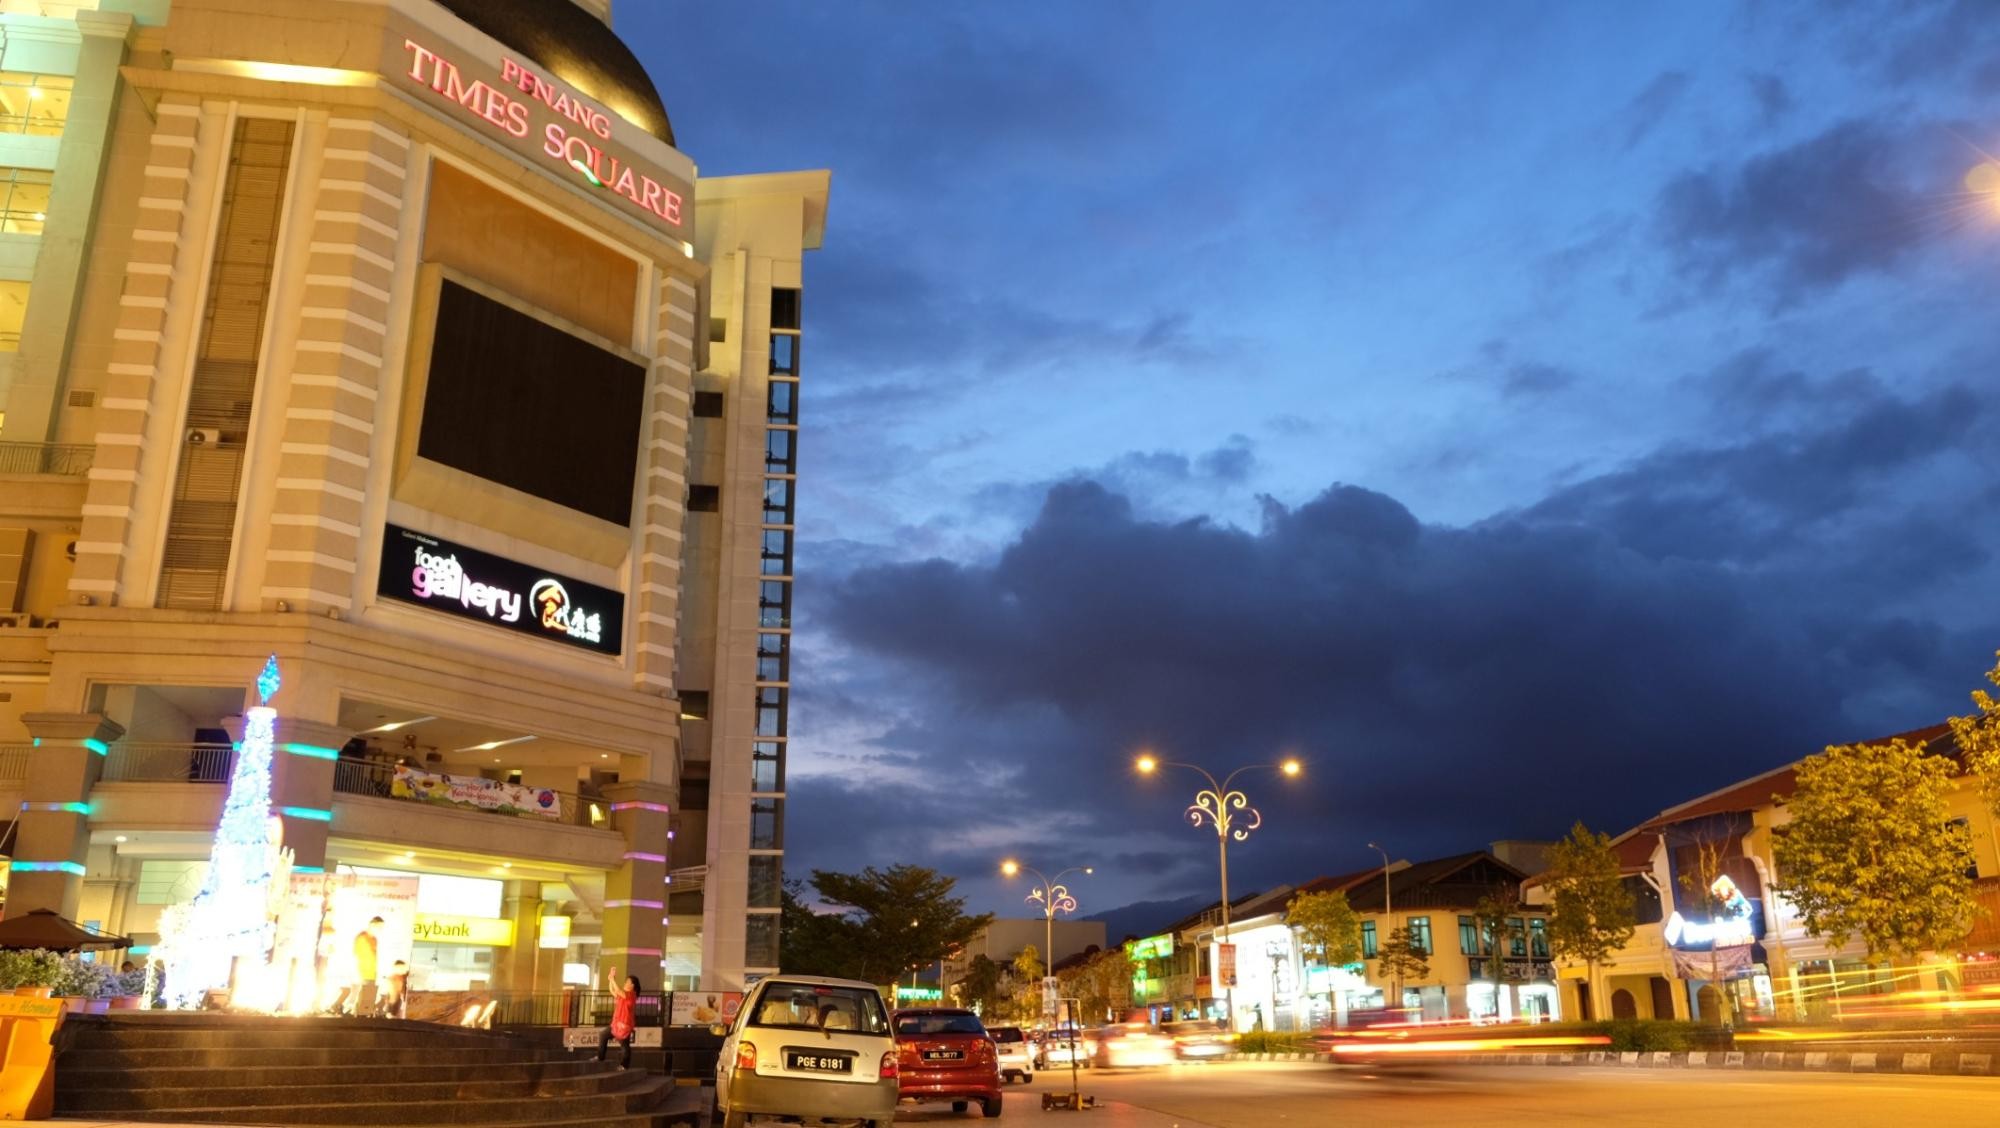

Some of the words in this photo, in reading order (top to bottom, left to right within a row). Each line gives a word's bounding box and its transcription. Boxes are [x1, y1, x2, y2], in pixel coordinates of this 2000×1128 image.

[500, 56, 612, 141] PENANG
[404, 38, 530, 139] TIMES
[543, 121, 683, 227] SQUARE
[414, 546, 461, 571] food
[411, 563, 522, 623] gallery
[413, 920, 470, 939] aybank
[797, 1055, 817, 1068] PGE
[819, 1058, 844, 1070] 6181
